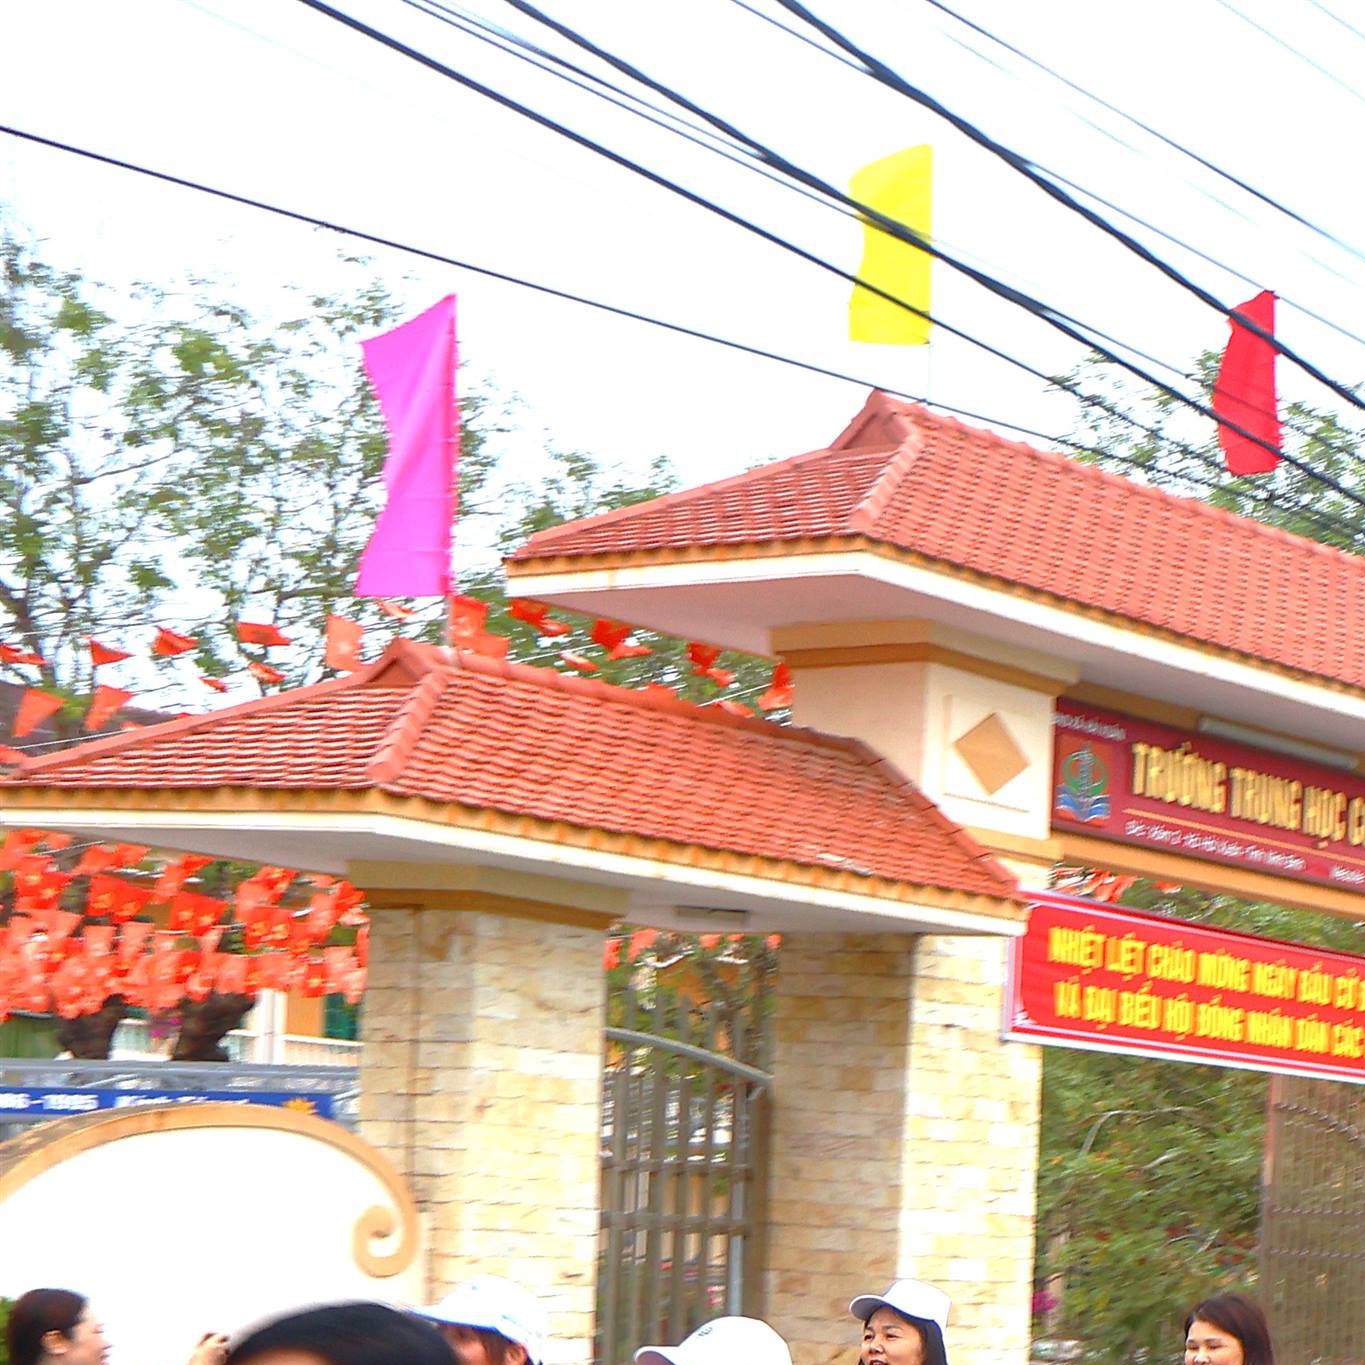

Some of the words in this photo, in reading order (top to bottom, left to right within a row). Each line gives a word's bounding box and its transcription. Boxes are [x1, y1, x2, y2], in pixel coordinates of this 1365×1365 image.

[1132, 741, 1227, 813] TRƯỜNG
[1230, 767, 1303, 830] TRUNG
[1303, 785, 1347, 849] HỌC
[1048, 925, 1106, 975] NHIỆT
[1106, 932, 1148, 981] LIỆT
[1147, 940, 1196, 983] CHÀO
[1197, 947, 1251, 993] MỪNG
[1251, 959, 1298, 1000] NGÀY
[1054, 975, 1082, 1019] VÀ
[1083, 985, 1119, 1030] ĐẠI
[1118, 980, 1163, 1030] BIỂU
[1196, 994, 1246, 1042] ĐỒNG
[1246, 1007, 1296, 1050] NHÂN
[1294, 1013, 1331, 1054] DÂN
[1330, 1018, 1365, 1060] CÁC
